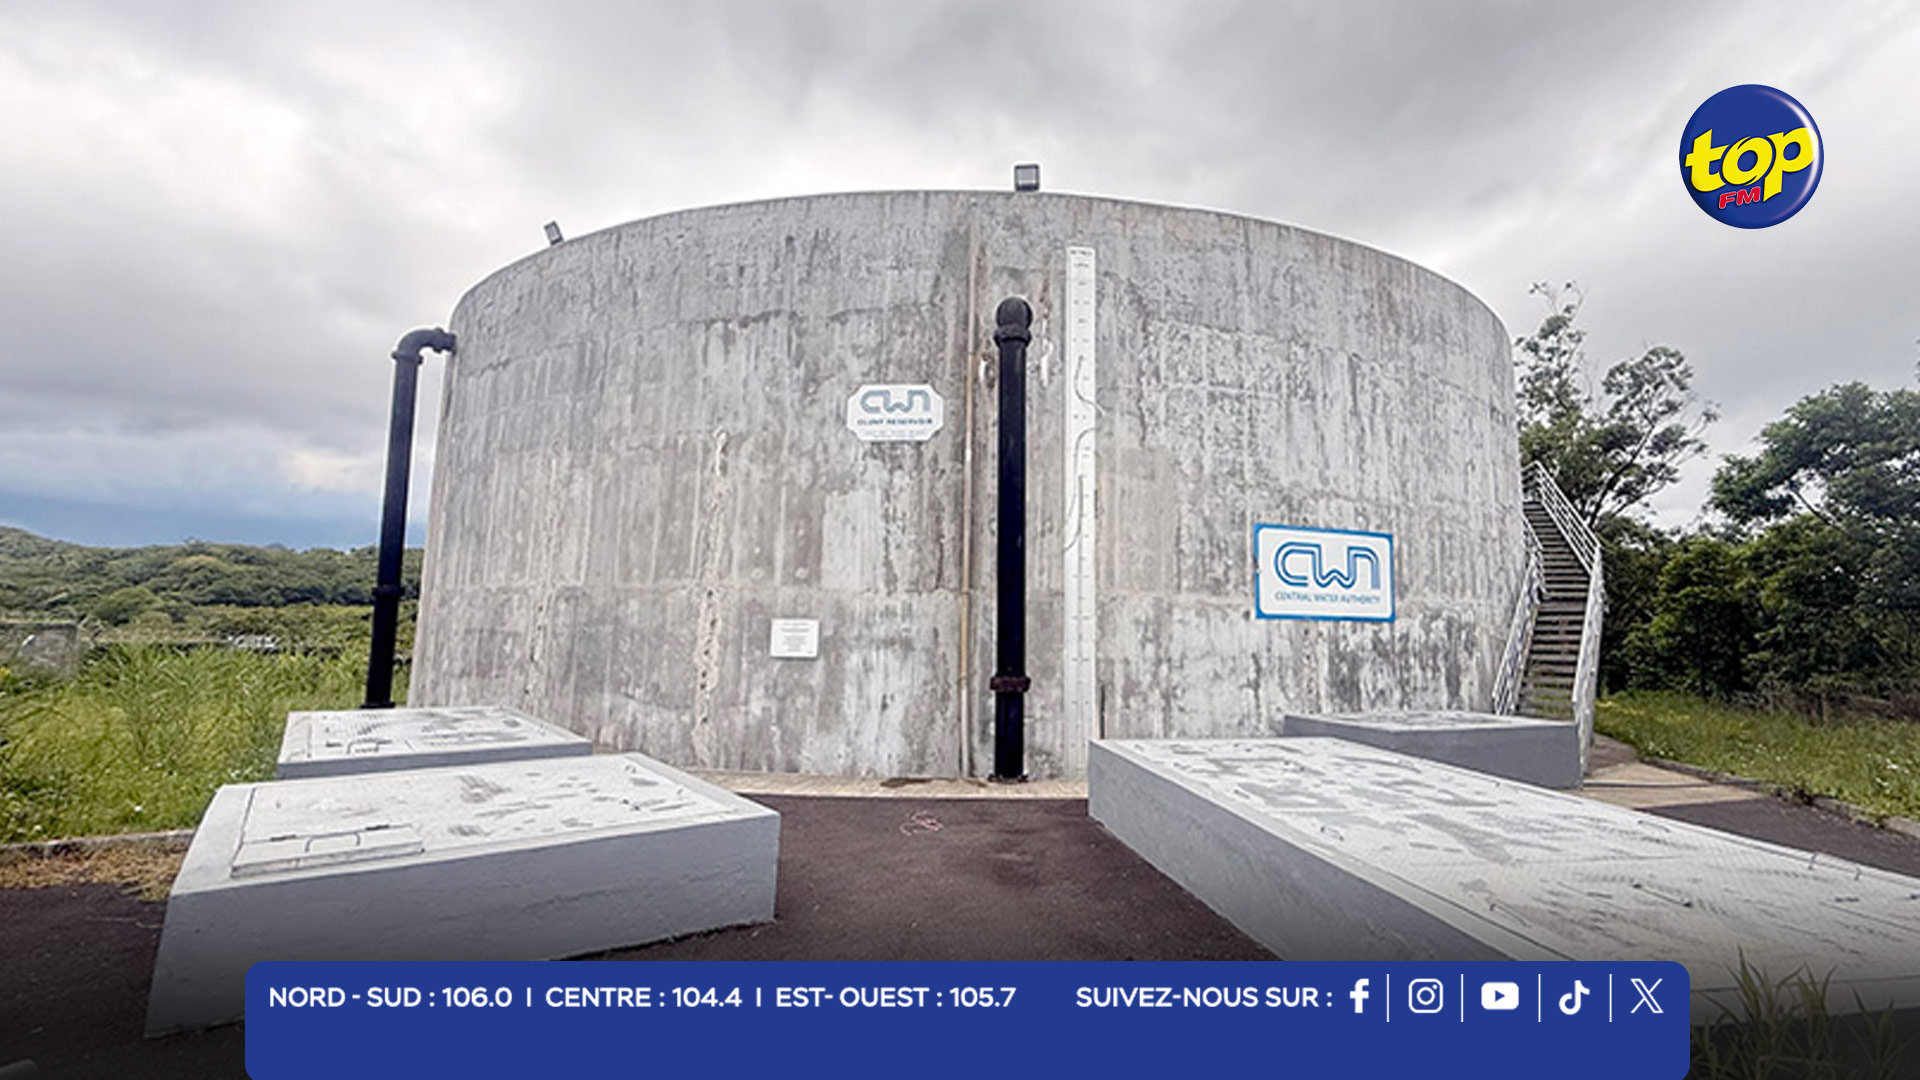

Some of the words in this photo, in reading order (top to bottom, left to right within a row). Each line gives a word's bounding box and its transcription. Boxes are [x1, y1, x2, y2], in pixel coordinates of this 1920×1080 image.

[1274, 591, 1311, 602] CENTRAL
[1314, 593, 1338, 603] WATER
[1340, 594, 1381, 604] AUTHORITY
